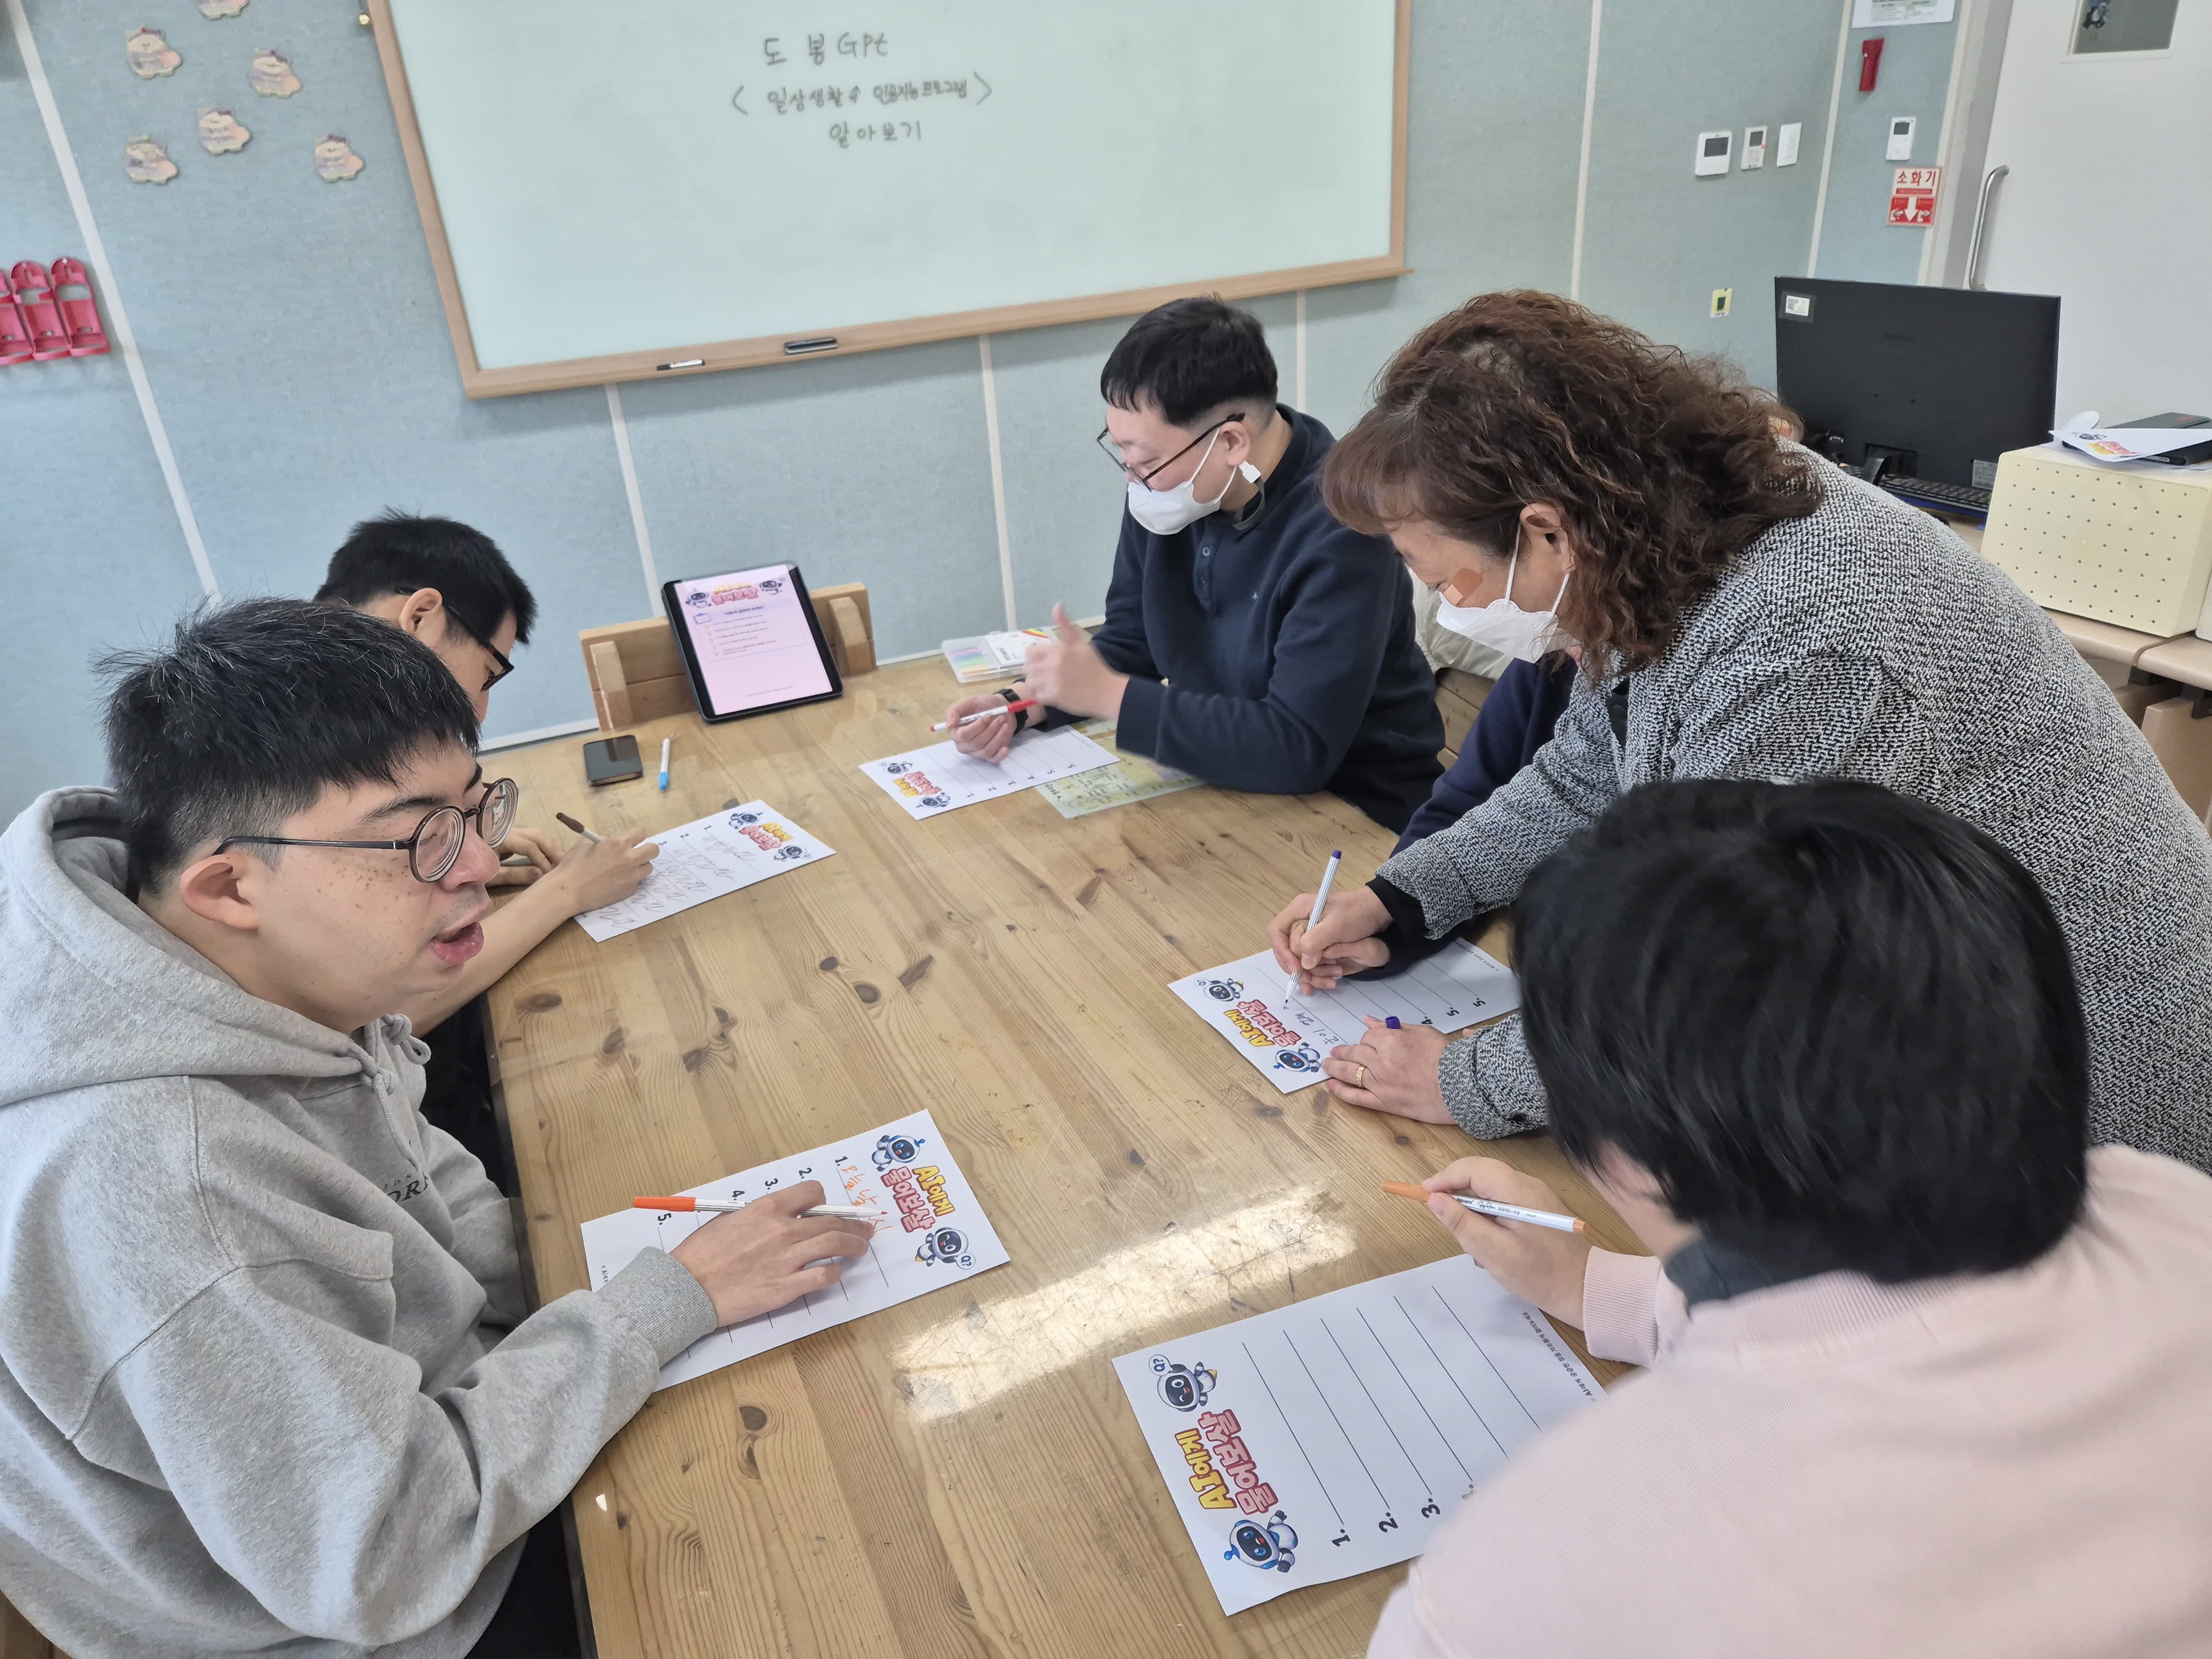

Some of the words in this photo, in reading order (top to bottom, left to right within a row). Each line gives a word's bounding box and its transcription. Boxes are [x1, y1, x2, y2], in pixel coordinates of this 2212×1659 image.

[1897, 171, 1936, 186] 소화기
[1223, 1009, 1275, 1047] AI에게
[1237, 999, 1302, 1047] 물어보살
[880, 1166, 936, 1233] 물어보살
[912, 1165, 955, 1217] AI에게
[1153, 1358, 1166, 1372] Q?
[1174, 1428, 1237, 1509] AI에게
[1197, 1409, 1279, 1515] 물어보살
[1379, 1512, 1399, 1533] 2.
[1421, 1498, 1441, 1519] 3.
[1332, 1529, 1350, 1547] 1.
